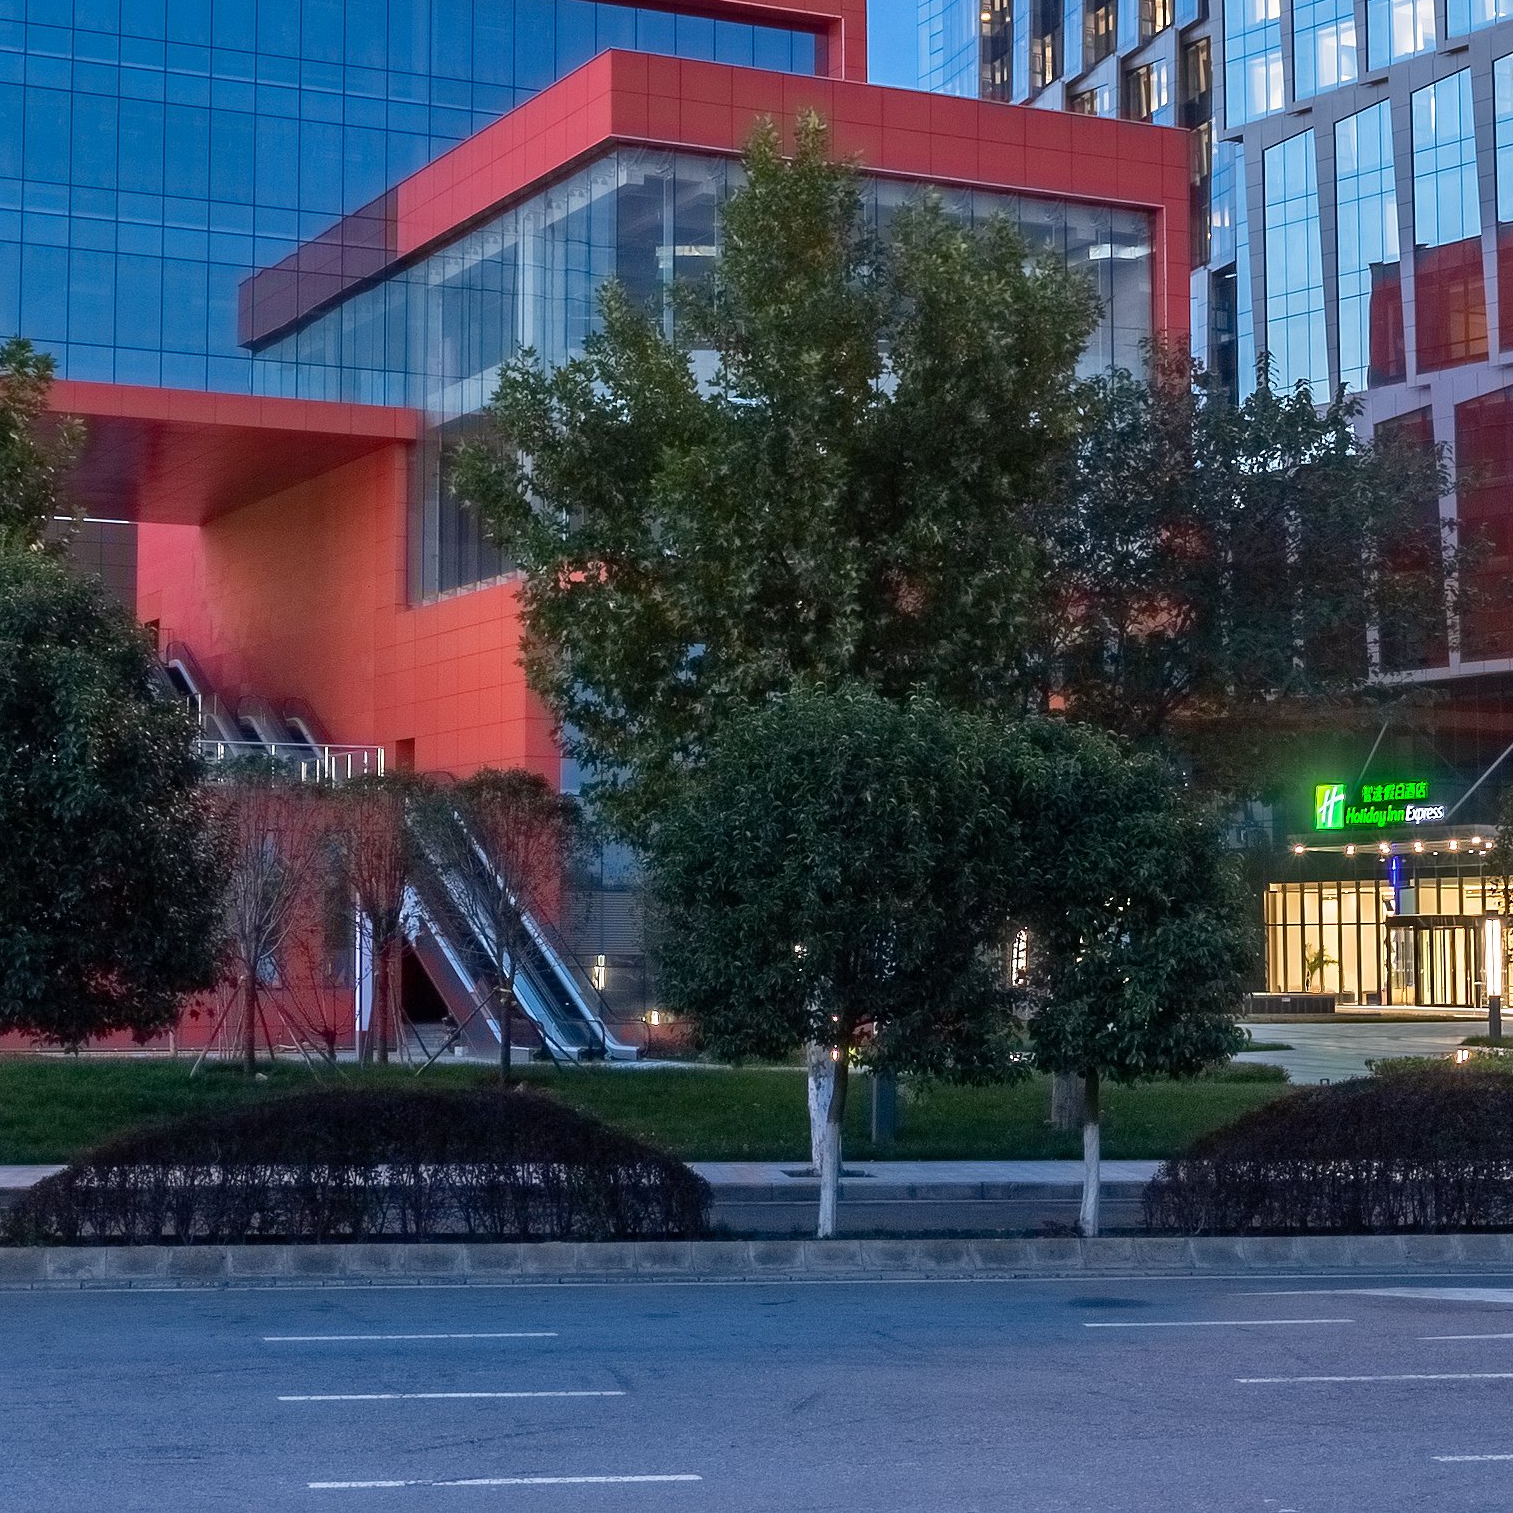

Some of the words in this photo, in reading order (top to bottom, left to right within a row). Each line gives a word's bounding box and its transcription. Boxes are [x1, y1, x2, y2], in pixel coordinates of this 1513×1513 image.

[1362, 781, 1427, 802] 智选假日酒店
[1345, 806, 1387, 827] Holiday
[1387, 805, 1405, 822] Inn
[1405, 804, 1445, 825] Express
